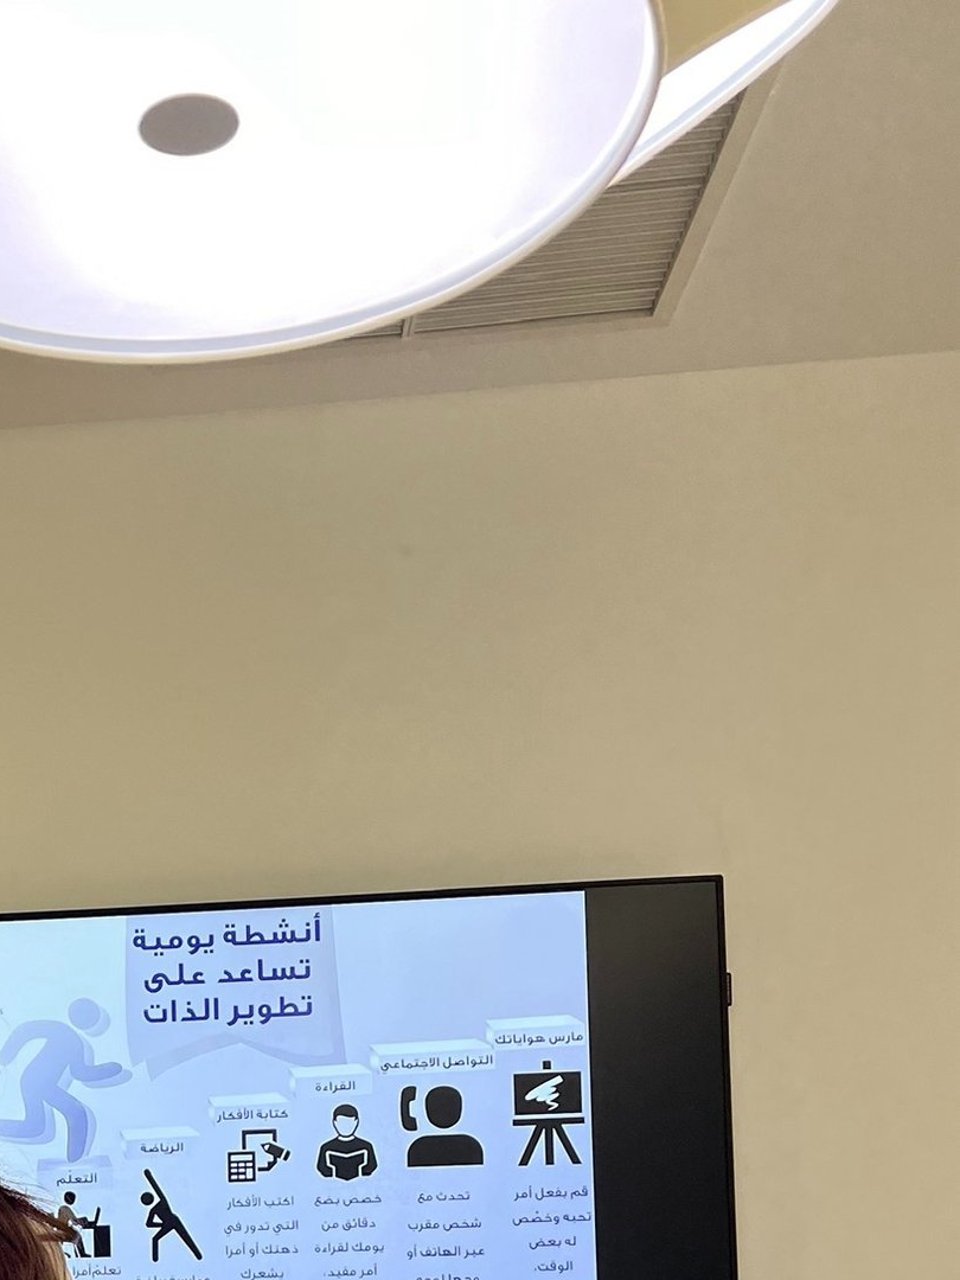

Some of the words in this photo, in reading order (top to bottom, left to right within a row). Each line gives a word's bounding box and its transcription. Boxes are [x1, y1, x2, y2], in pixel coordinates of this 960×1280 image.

[223, 912, 321, 946] أنشطة
[133, 928, 214, 956] يومية
[144, 963, 206, 994] على
[218, 959, 311, 984] تساعد
[143, 997, 219, 1023] الذات
[226, 995, 313, 1026] تطوير
[494, 1033, 546, 1047] هواياتك
[548, 1031, 584, 1045] مارس
[380, 1057, 440, 1075] الاجتماعي
[442, 1055, 493, 1070] التواصل
[315, 1081, 356, 1094] القراءة
[216, 1107, 253, 1124] الأفكار
[256, 1109, 289, 1122] كتابة
[140, 1143, 184, 1155] الرياضة
[417, 1192, 434, 1204] مع
[435, 1190, 471, 1202] تحدث
[513, 1185, 532, 1202] أمر
[535, 1187, 568, 1201] بفعل
[570, 1186, 588, 1200] قم
[226, 1193, 261, 1211] الأفكار
[263, 1195, 294, 1209] اكتب
[313, 1196, 340, 1208] بضع
[562, 1211, 592, 1223] تحبه
[223, 1220, 242, 1237] في
[244, 1221, 270, 1235] تدور
[272, 1219, 299, 1236] التي
[320, 1220, 340, 1232] من
[341, 1217, 376, 1232] دقائق
[407, 1219, 440, 1233] مقرب
[442, 1217, 482, 1232] شخص
[314, 1241, 349, 1256] لقراءة
[351, 1241, 385, 1255] يومك
[528, 1237, 562, 1250] بعض
[564, 1236, 577, 1247] له
[225, 1241, 246, 1259] أمرا
[248, 1241, 259, 1258] أو
[261, 1244, 299, 1255] ذهنك
[406, 1243, 418, 1261] أو
[419, 1245, 461, 1257] الهاتف
[463, 1247, 485, 1260] عبر
[358, 1262, 378, 1279] أمر
